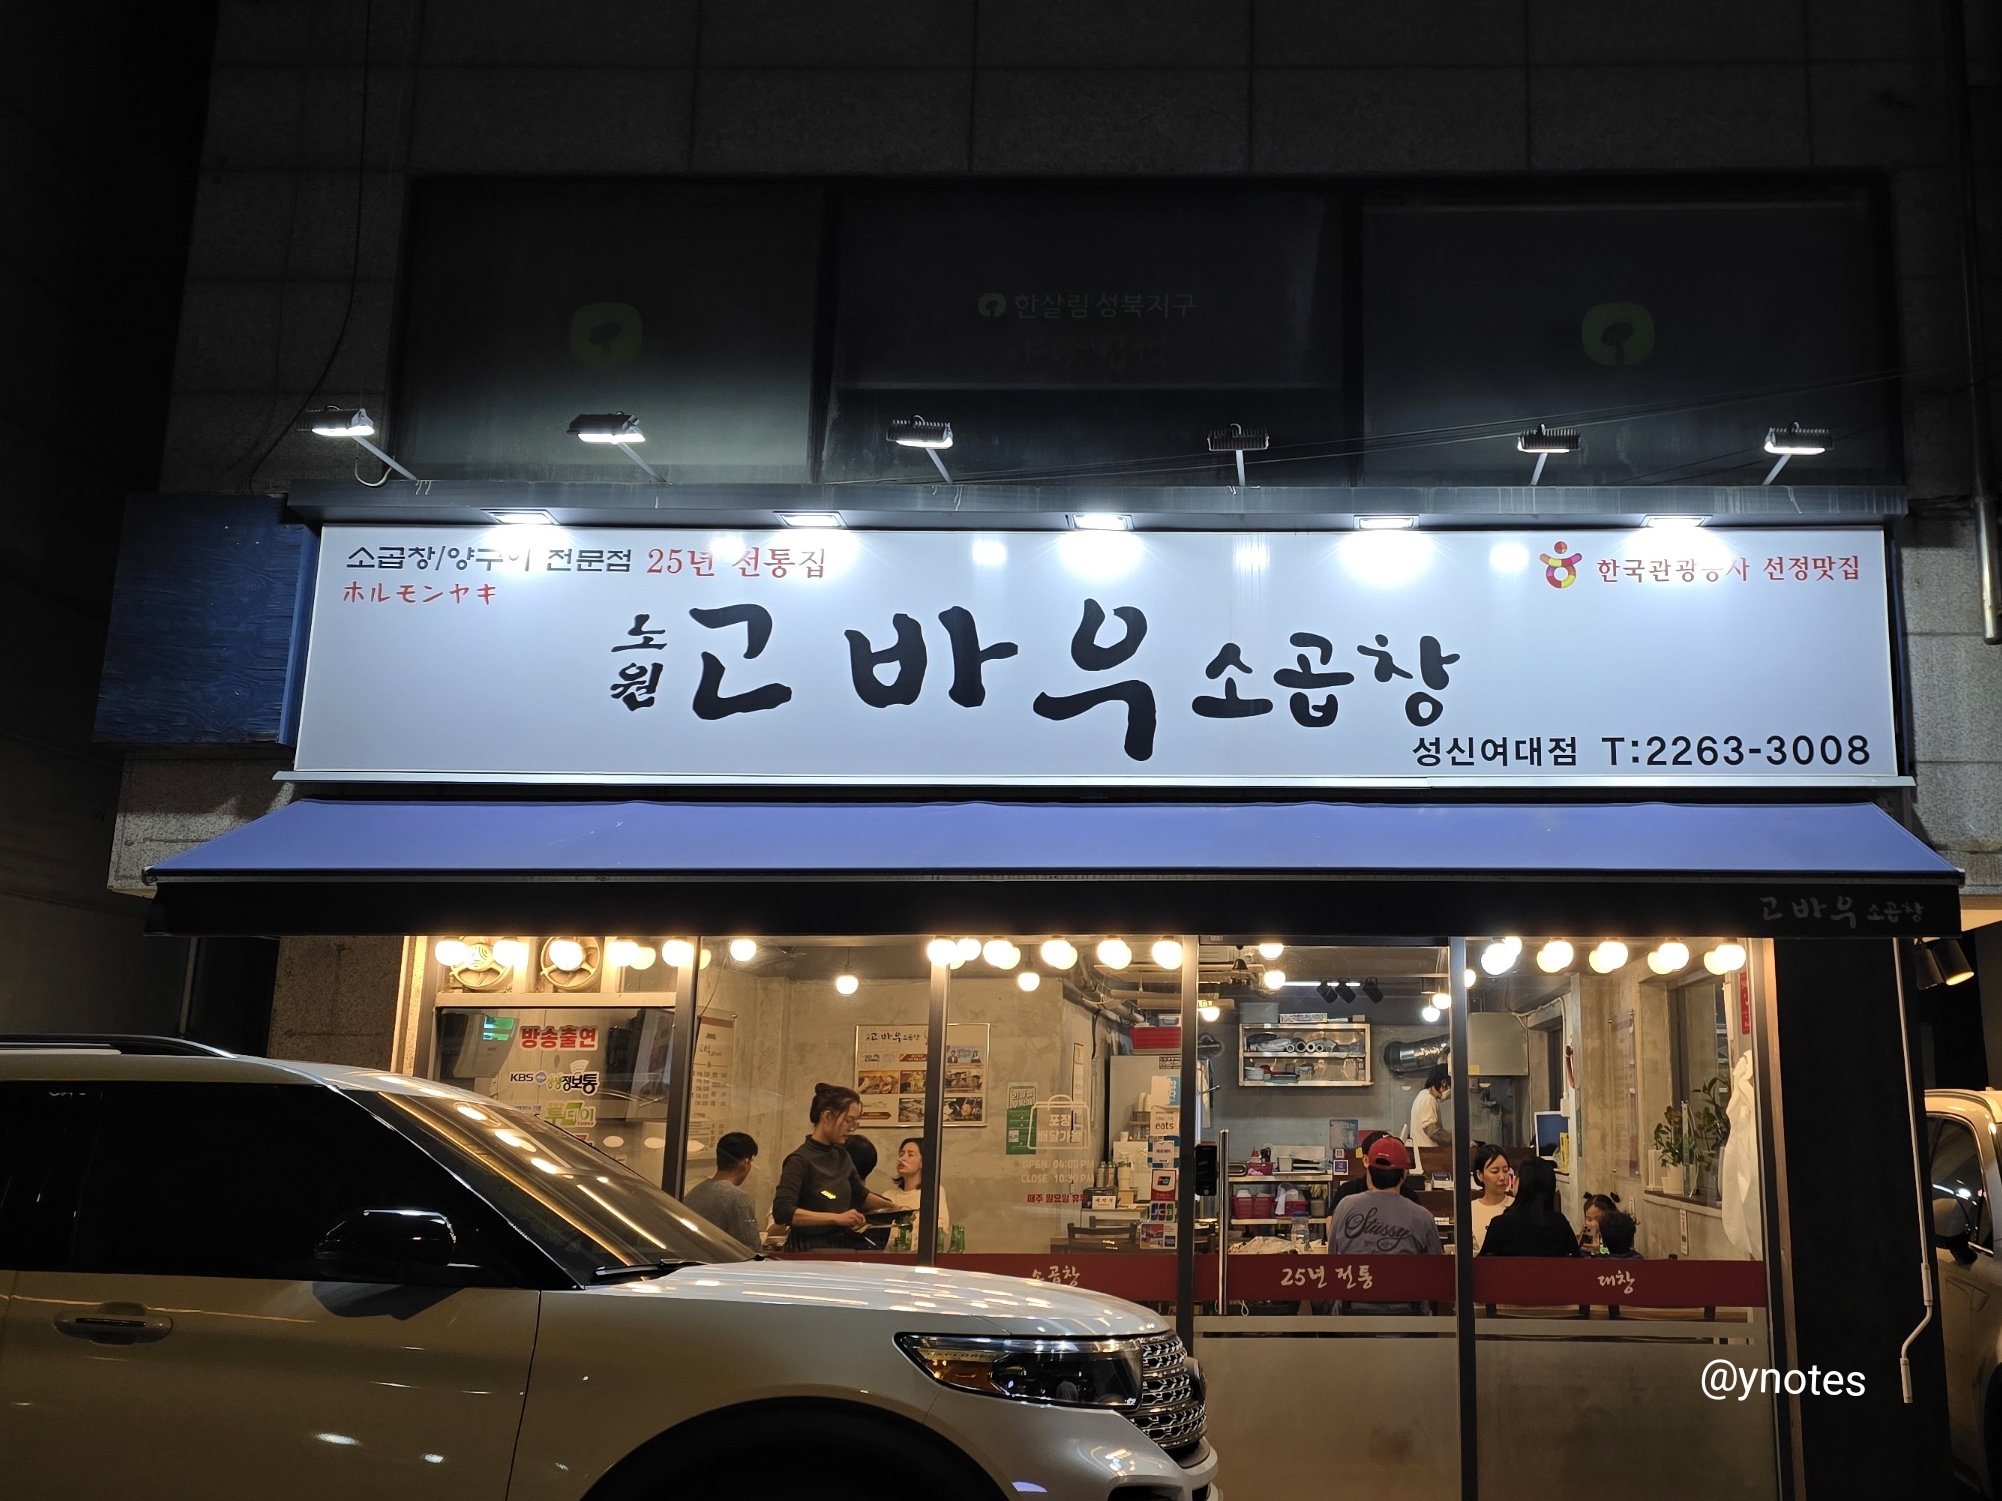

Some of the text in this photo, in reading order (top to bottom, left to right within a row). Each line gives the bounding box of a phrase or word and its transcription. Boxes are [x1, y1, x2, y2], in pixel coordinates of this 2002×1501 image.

[1015, 292, 1197, 319] 한살림 성북지구
[346, 545, 632, 573] 소곱창/양구이 전문점
[646, 548, 715, 577] 25년
[1762, 555, 1860, 582] 선정맛집
[343, 580, 497, 605] ホルモンヤキ
[609, 613, 667, 712] 노원
[1191, 631, 1460, 728] 소곱창
[1412, 735, 1579, 768] 성신여대점
[1759, 895, 1925, 930] 고바우 소곱창
[521, 1027, 597, 1049] 방송출연
[510, 1073, 534, 1082] KBS
[1154, 1120, 1175, 1131] eats
[1021, 1160, 1048, 1169] OPEN
[1080, 1160, 1095, 1169] PM
[1021, 1174, 1048, 1183] CLOSE
[1080, 1174, 1095, 1183] PM
[1027, 1193, 1044, 1203] 매주
[1046, 1193, 1069, 1203] 일요일
[1150, 1207, 1174, 1217] JCB
[1281, 1264, 1373, 1290] 25년 전통
[1597, 1269, 1636, 1295] 대창
